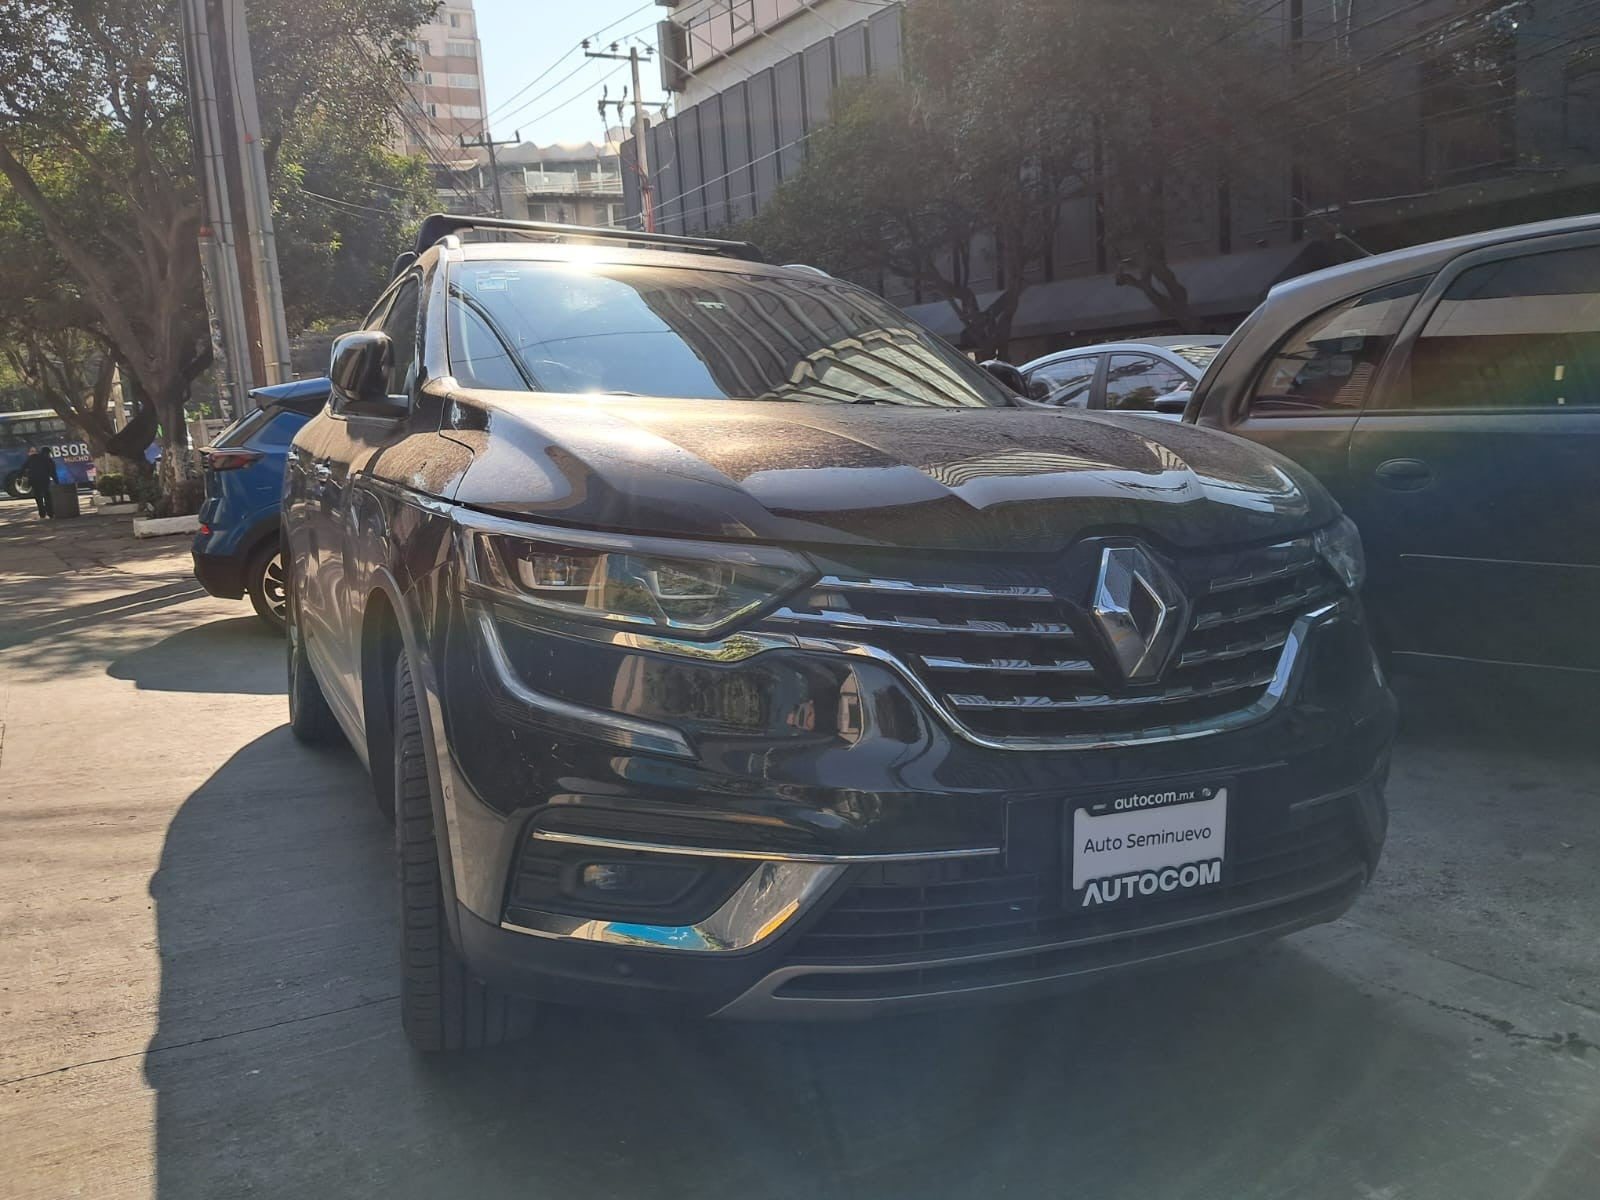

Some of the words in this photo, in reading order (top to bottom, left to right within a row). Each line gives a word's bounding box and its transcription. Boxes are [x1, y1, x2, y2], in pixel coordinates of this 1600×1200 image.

[1114, 790, 1195, 810] autocom.mx
[1083, 837, 1122, 854] Auto
[1126, 826, 1212, 848] Seminuevo
[1082, 861, 1221, 907] AUTOCOM
